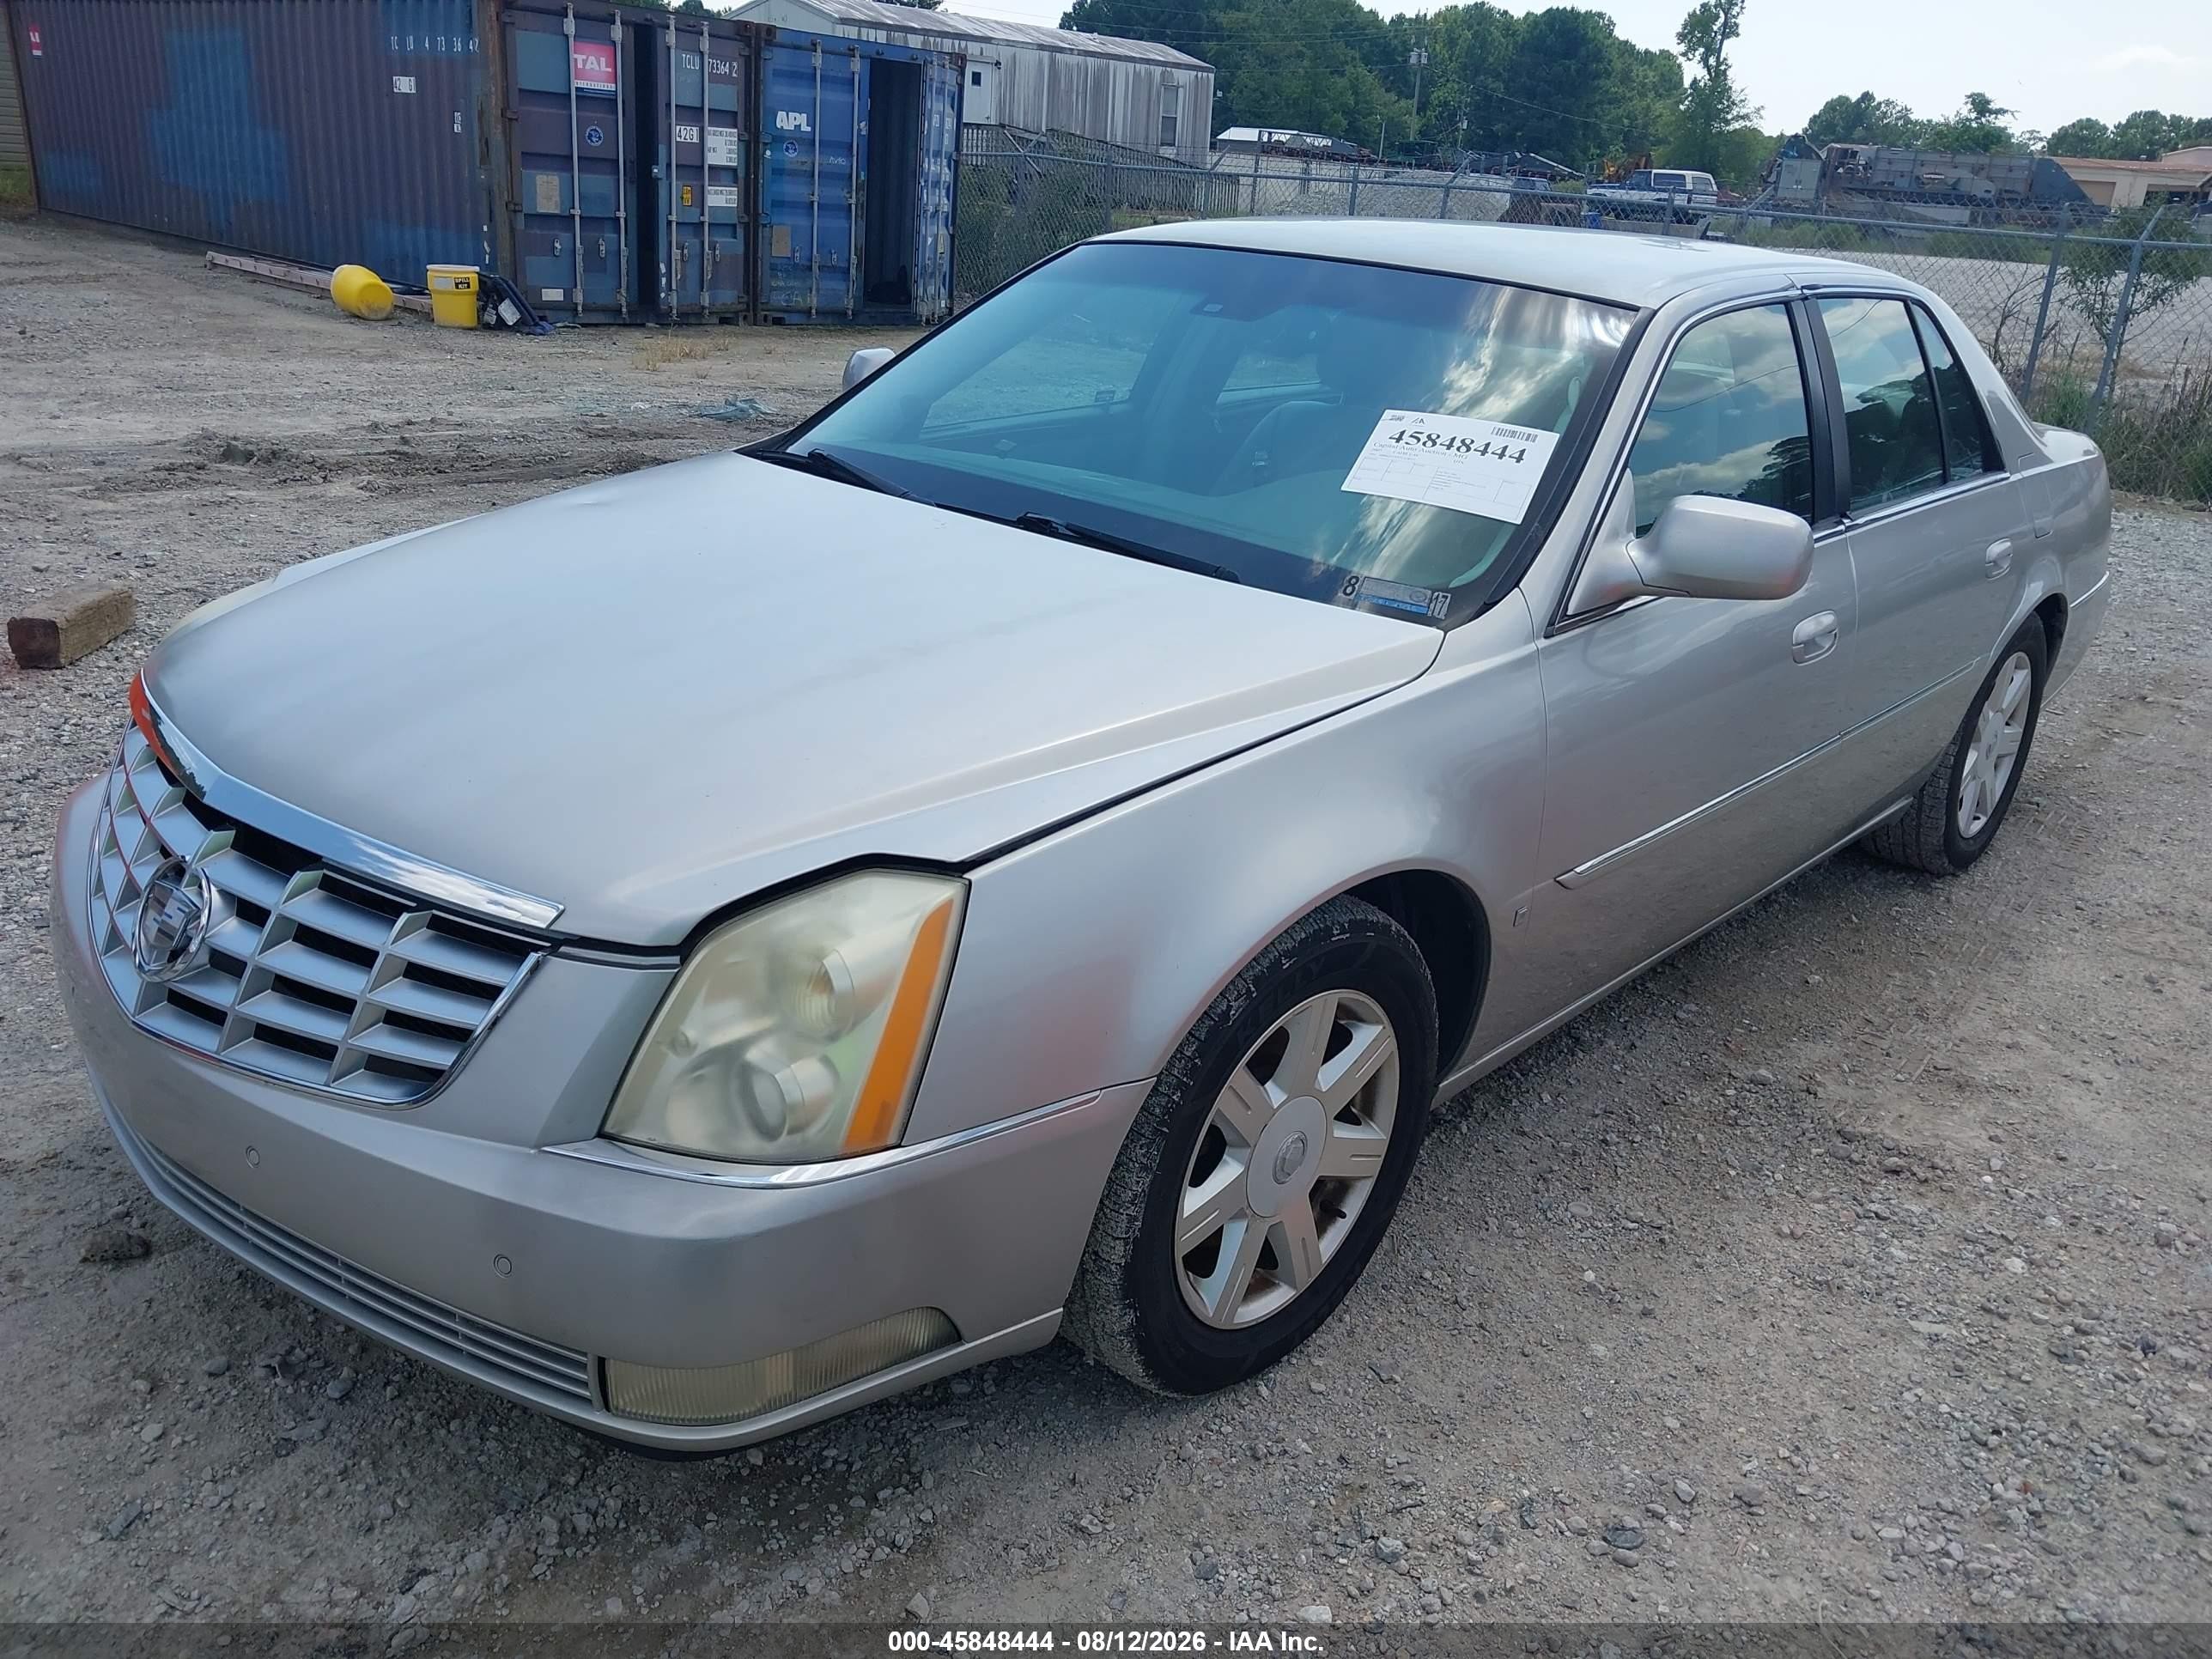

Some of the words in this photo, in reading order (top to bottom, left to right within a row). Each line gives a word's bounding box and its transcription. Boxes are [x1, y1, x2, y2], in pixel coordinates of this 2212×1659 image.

[573, 53, 612, 72] TAL
[682, 53, 700, 70] TCLU
[776, 111, 811, 131] APL
[677, 127, 699, 142] 42G1
[1388, 428, 1528, 464] 45848444
[1342, 575, 1360, 597] 8
[1431, 592, 1450, 617] 17
